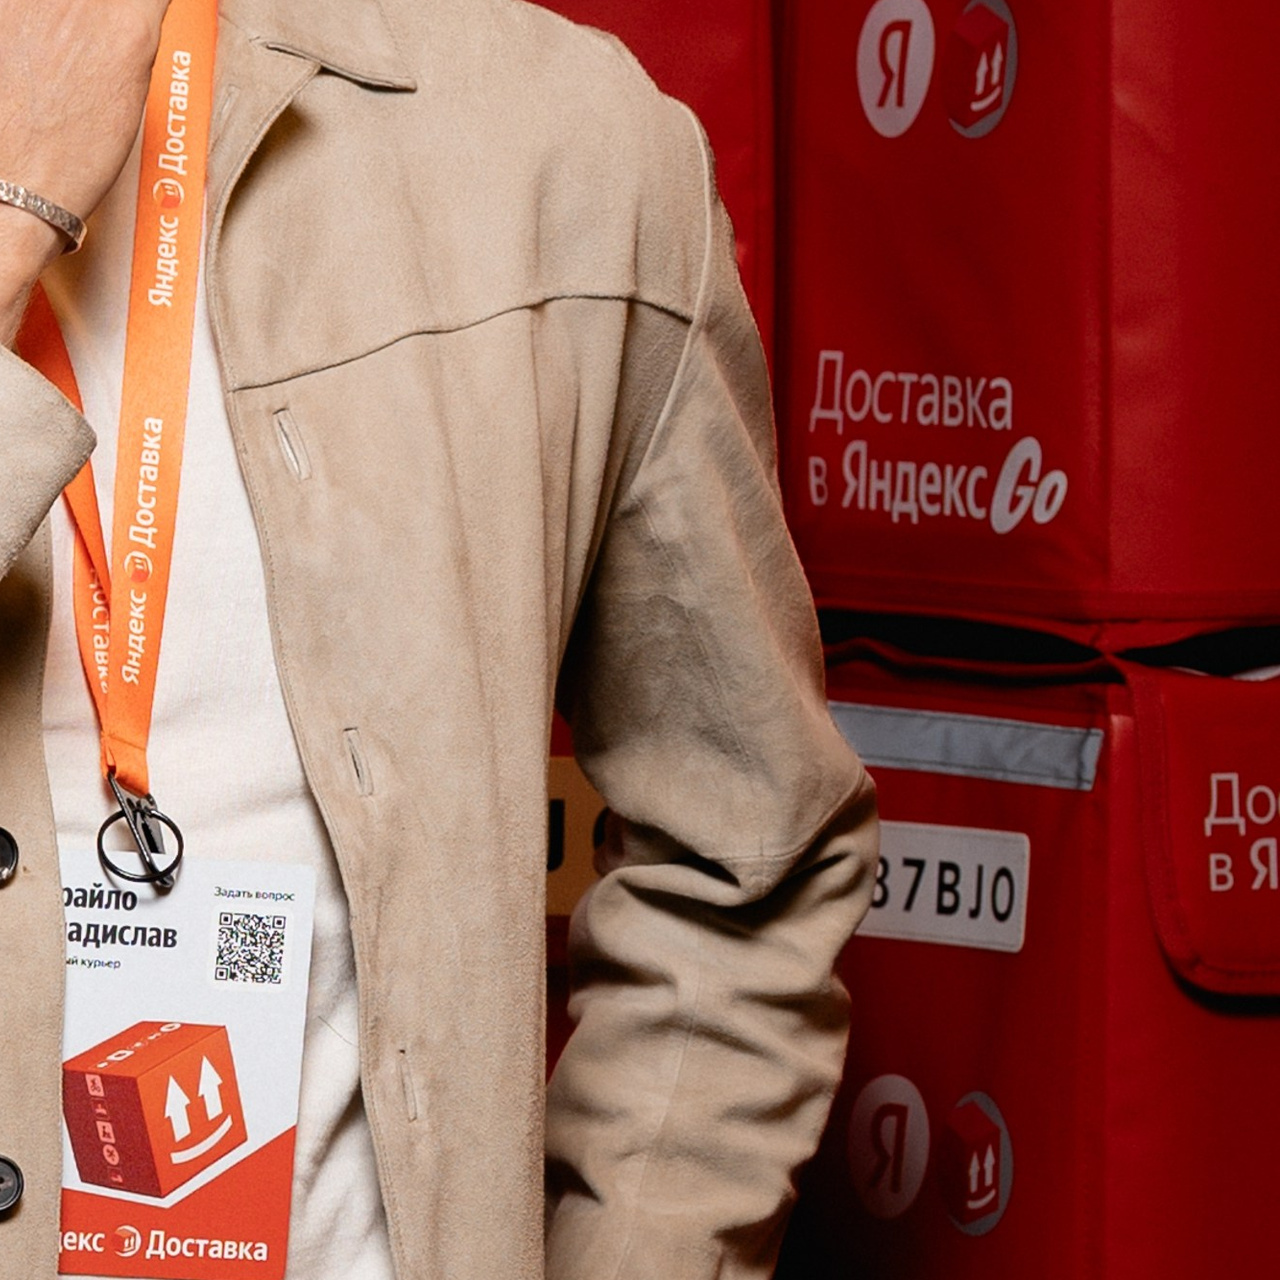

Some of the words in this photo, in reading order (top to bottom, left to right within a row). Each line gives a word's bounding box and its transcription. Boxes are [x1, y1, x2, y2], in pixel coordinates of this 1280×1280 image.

[158, 49, 192, 175] Доставка
[147, 214, 179, 308] Яндекс
[809, 349, 1013, 435] Доставка
[128, 416, 163, 550] Доставка
[808, 455, 829, 507] в
[841, 439, 989, 525] Яндекс
[989, 436, 1068, 535] Go
[121, 588, 148, 686] Яндекс
[214, 886, 253, 898] Задать
[254, 891, 295, 902] вопрос
[1209, 852, 1235, 892] в
[65, 922, 177, 949] адислав
[80, 958, 121, 970] курьер
[145, 1229, 269, 1261] Доставка
